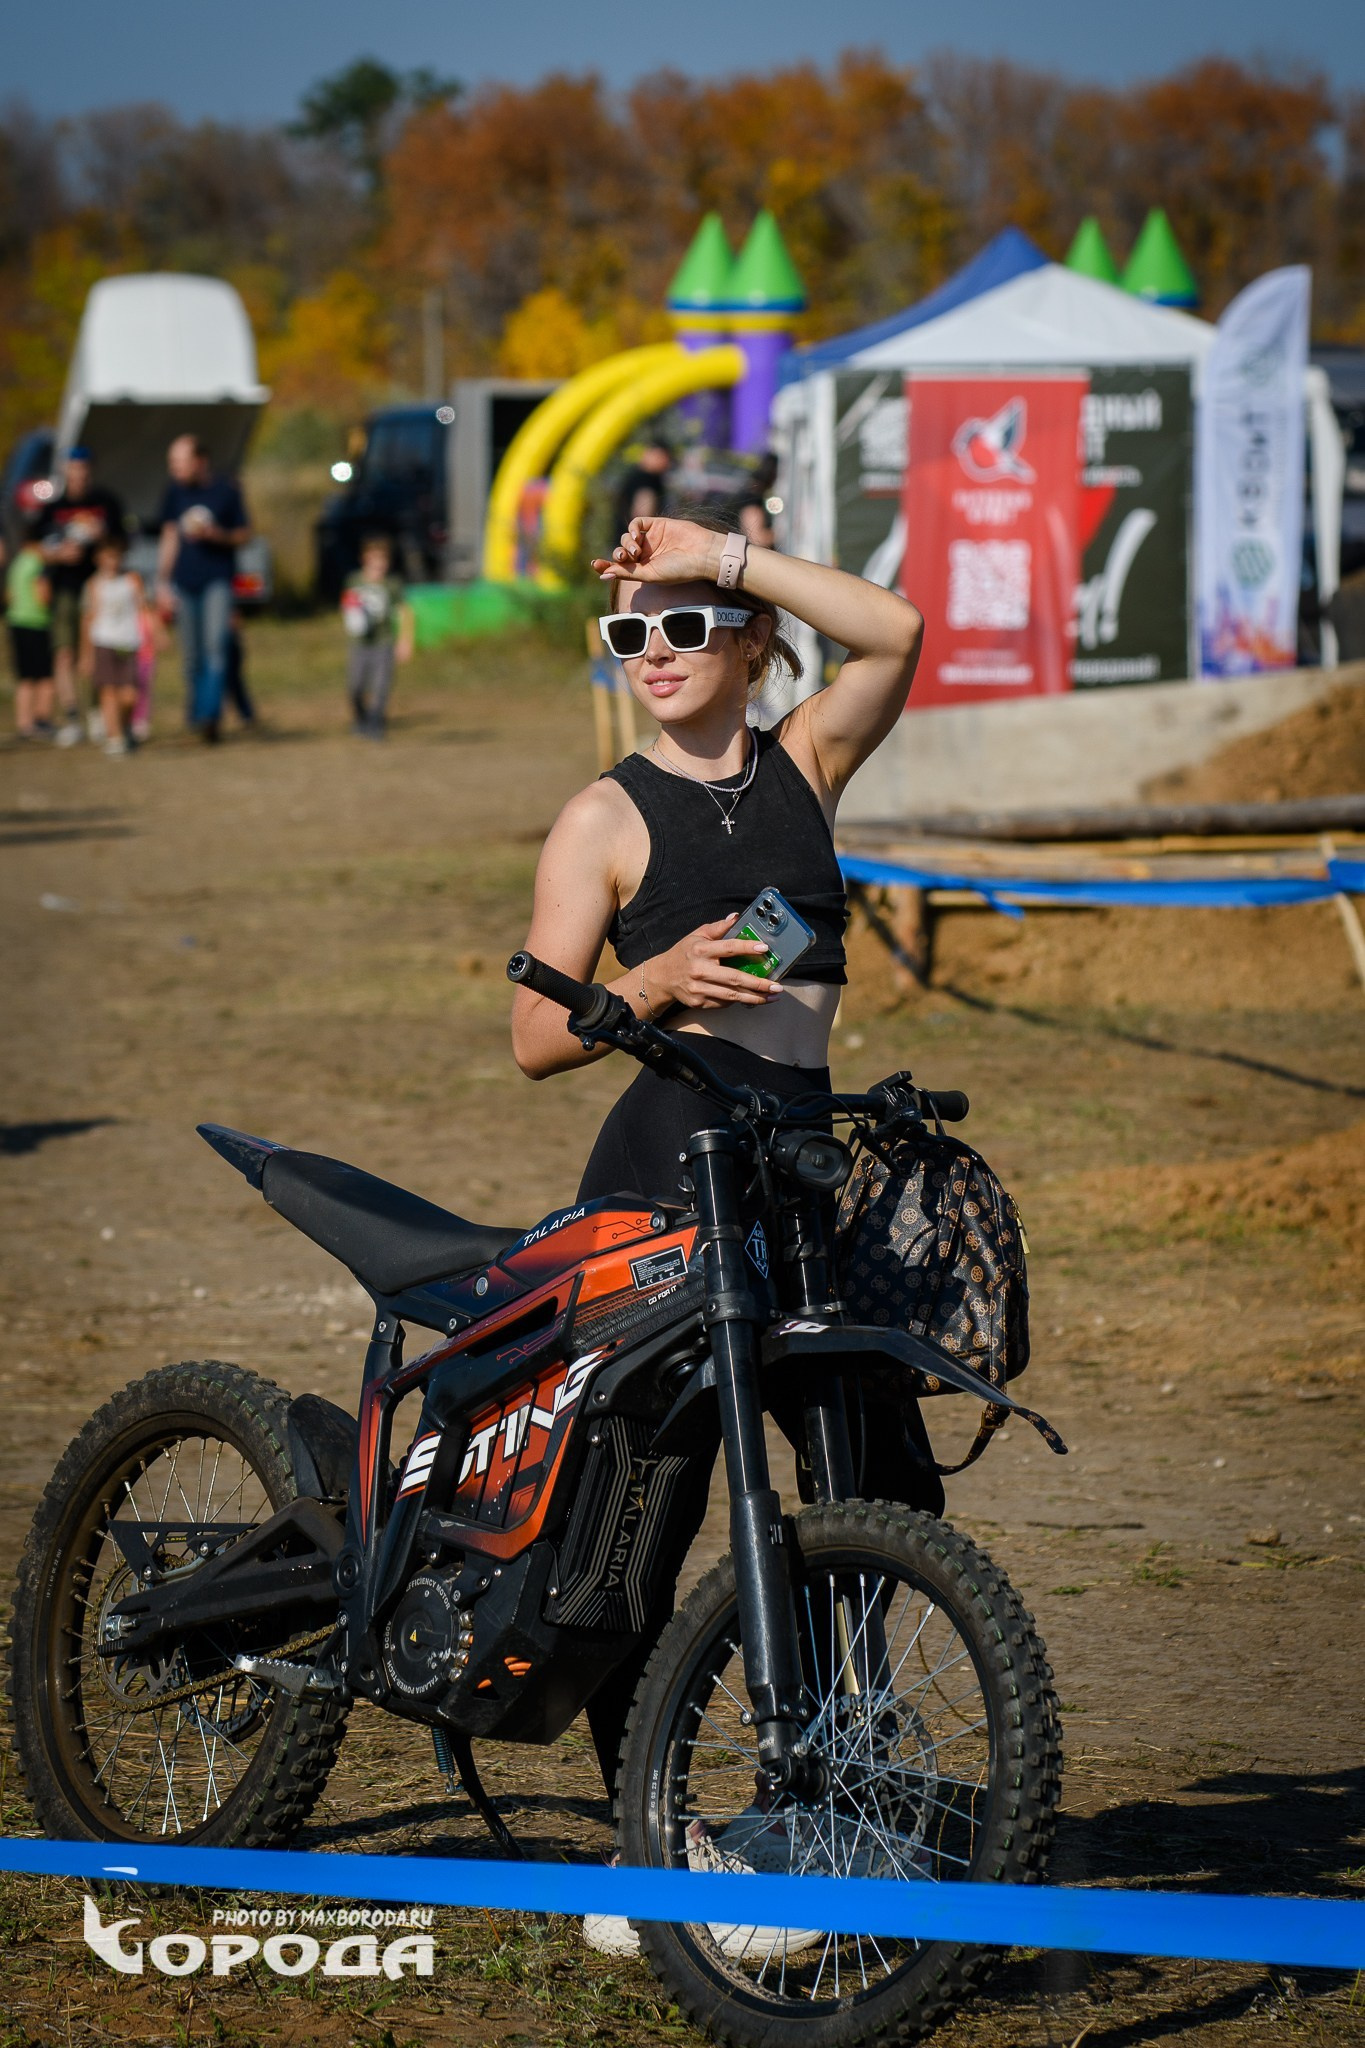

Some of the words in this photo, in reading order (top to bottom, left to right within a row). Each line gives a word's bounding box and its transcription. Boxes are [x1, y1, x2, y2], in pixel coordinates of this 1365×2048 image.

[647, 1296, 658, 1306] GO
[657, 1288, 671, 1300] FOR
[670, 1284, 677, 1293] IT
[604, 1483, 646, 1588] TALARIA
[435, 1583, 451, 1610] MOTOR
[415, 1675, 438, 1694] TALARIA
